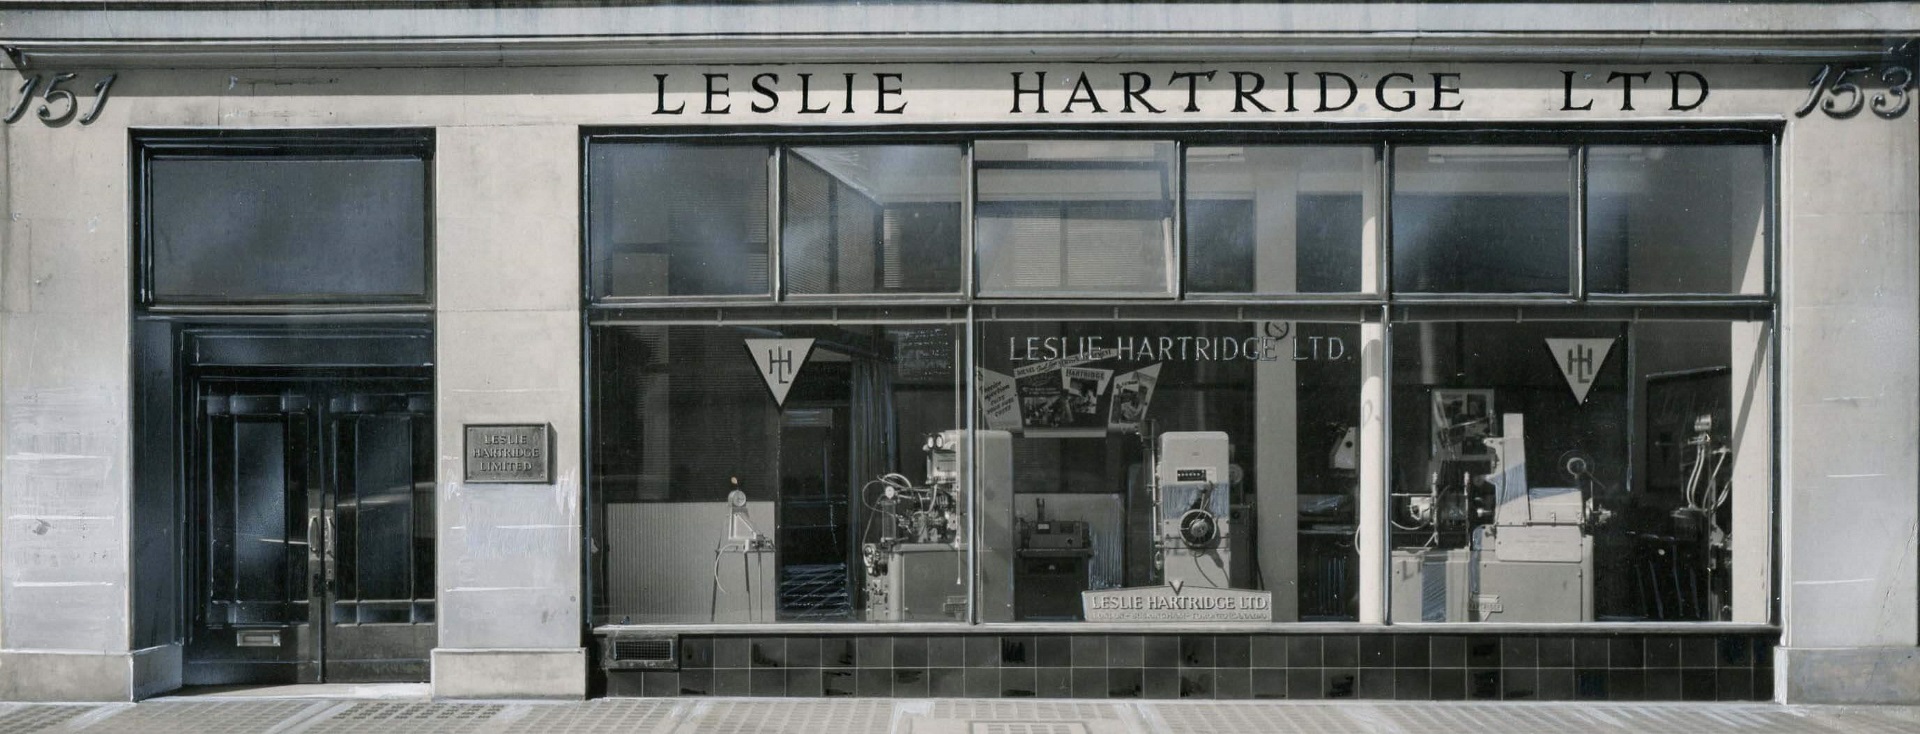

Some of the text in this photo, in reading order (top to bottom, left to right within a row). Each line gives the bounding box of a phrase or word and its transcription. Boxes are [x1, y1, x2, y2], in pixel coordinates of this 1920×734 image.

[4, 72, 118, 128] 151
[652, 69, 1709, 115] LESLIE HARTRIDGE LTD
[1795, 64, 1912, 120] 153
[1009, 336, 1102, 361] LESLIE
[1117, 336, 1278, 361] HARTRIDGE
[1291, 336, 1352, 361] LTD.
[483, 434, 528, 445] LESLIE
[473, 447, 540, 459] HARTRIDGE
[480, 461, 533, 472] LIMITED
[1091, 596, 1143, 610] LESLIE
[1149, 596, 1236, 610] HARTRIDGE
